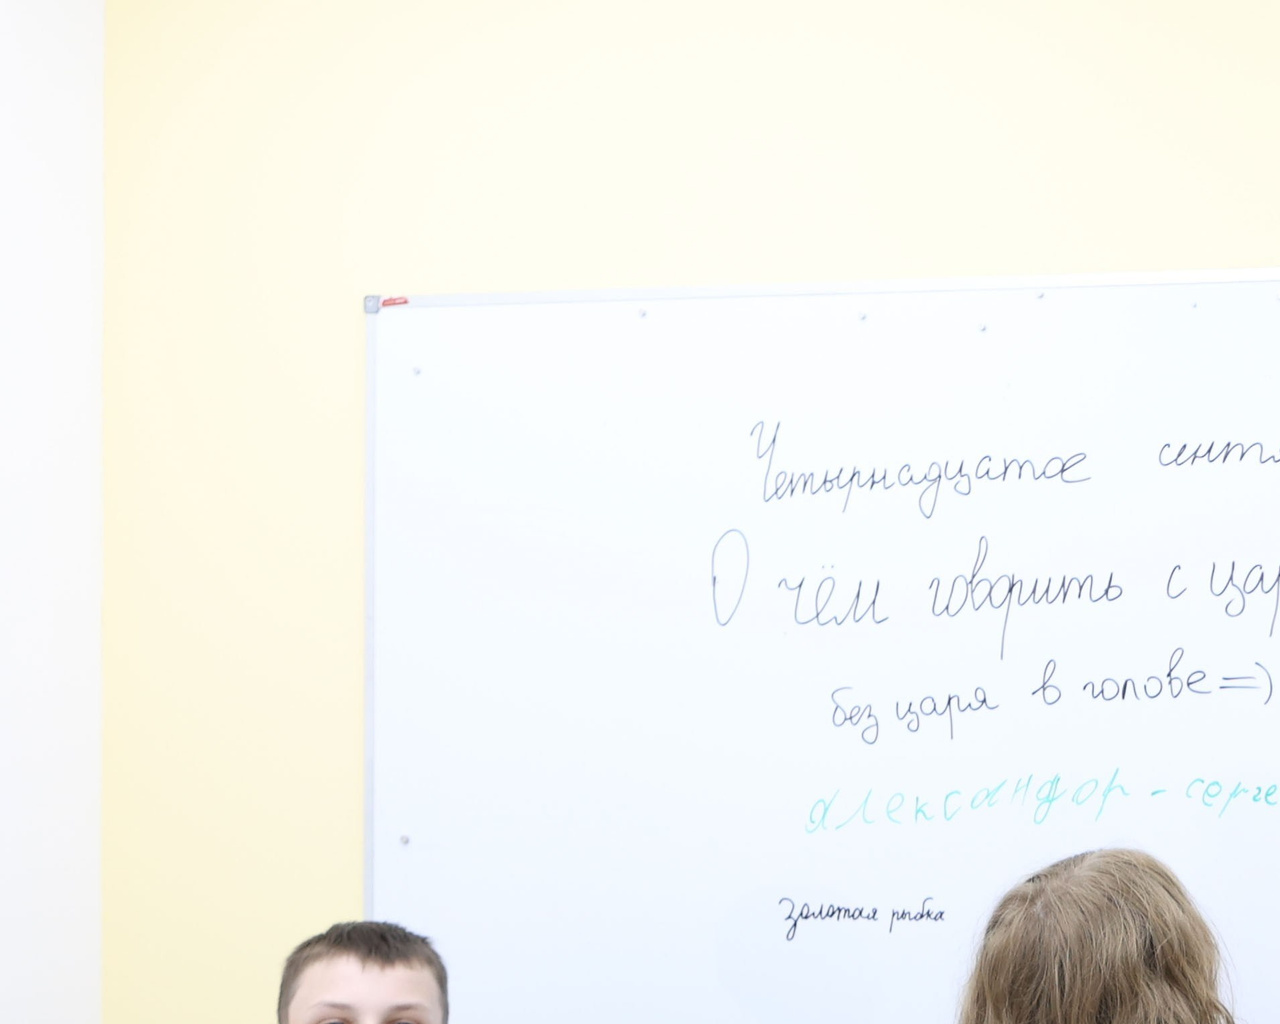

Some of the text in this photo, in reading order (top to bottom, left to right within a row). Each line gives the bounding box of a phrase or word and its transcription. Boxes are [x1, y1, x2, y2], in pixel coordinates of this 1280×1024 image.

[749, 419, 1092, 520] Четырнадцатое
[710, 527, 750, 628] О
[777, 564, 890, 627] чём
[928, 535, 1124, 661] говорить
[1165, 563, 1189, 600] с
[830, 686, 880, 746] без
[895, 686, 1000, 741] царя
[1030, 658, 1063, 707] в
[888, 895, 947, 934] рыбка
